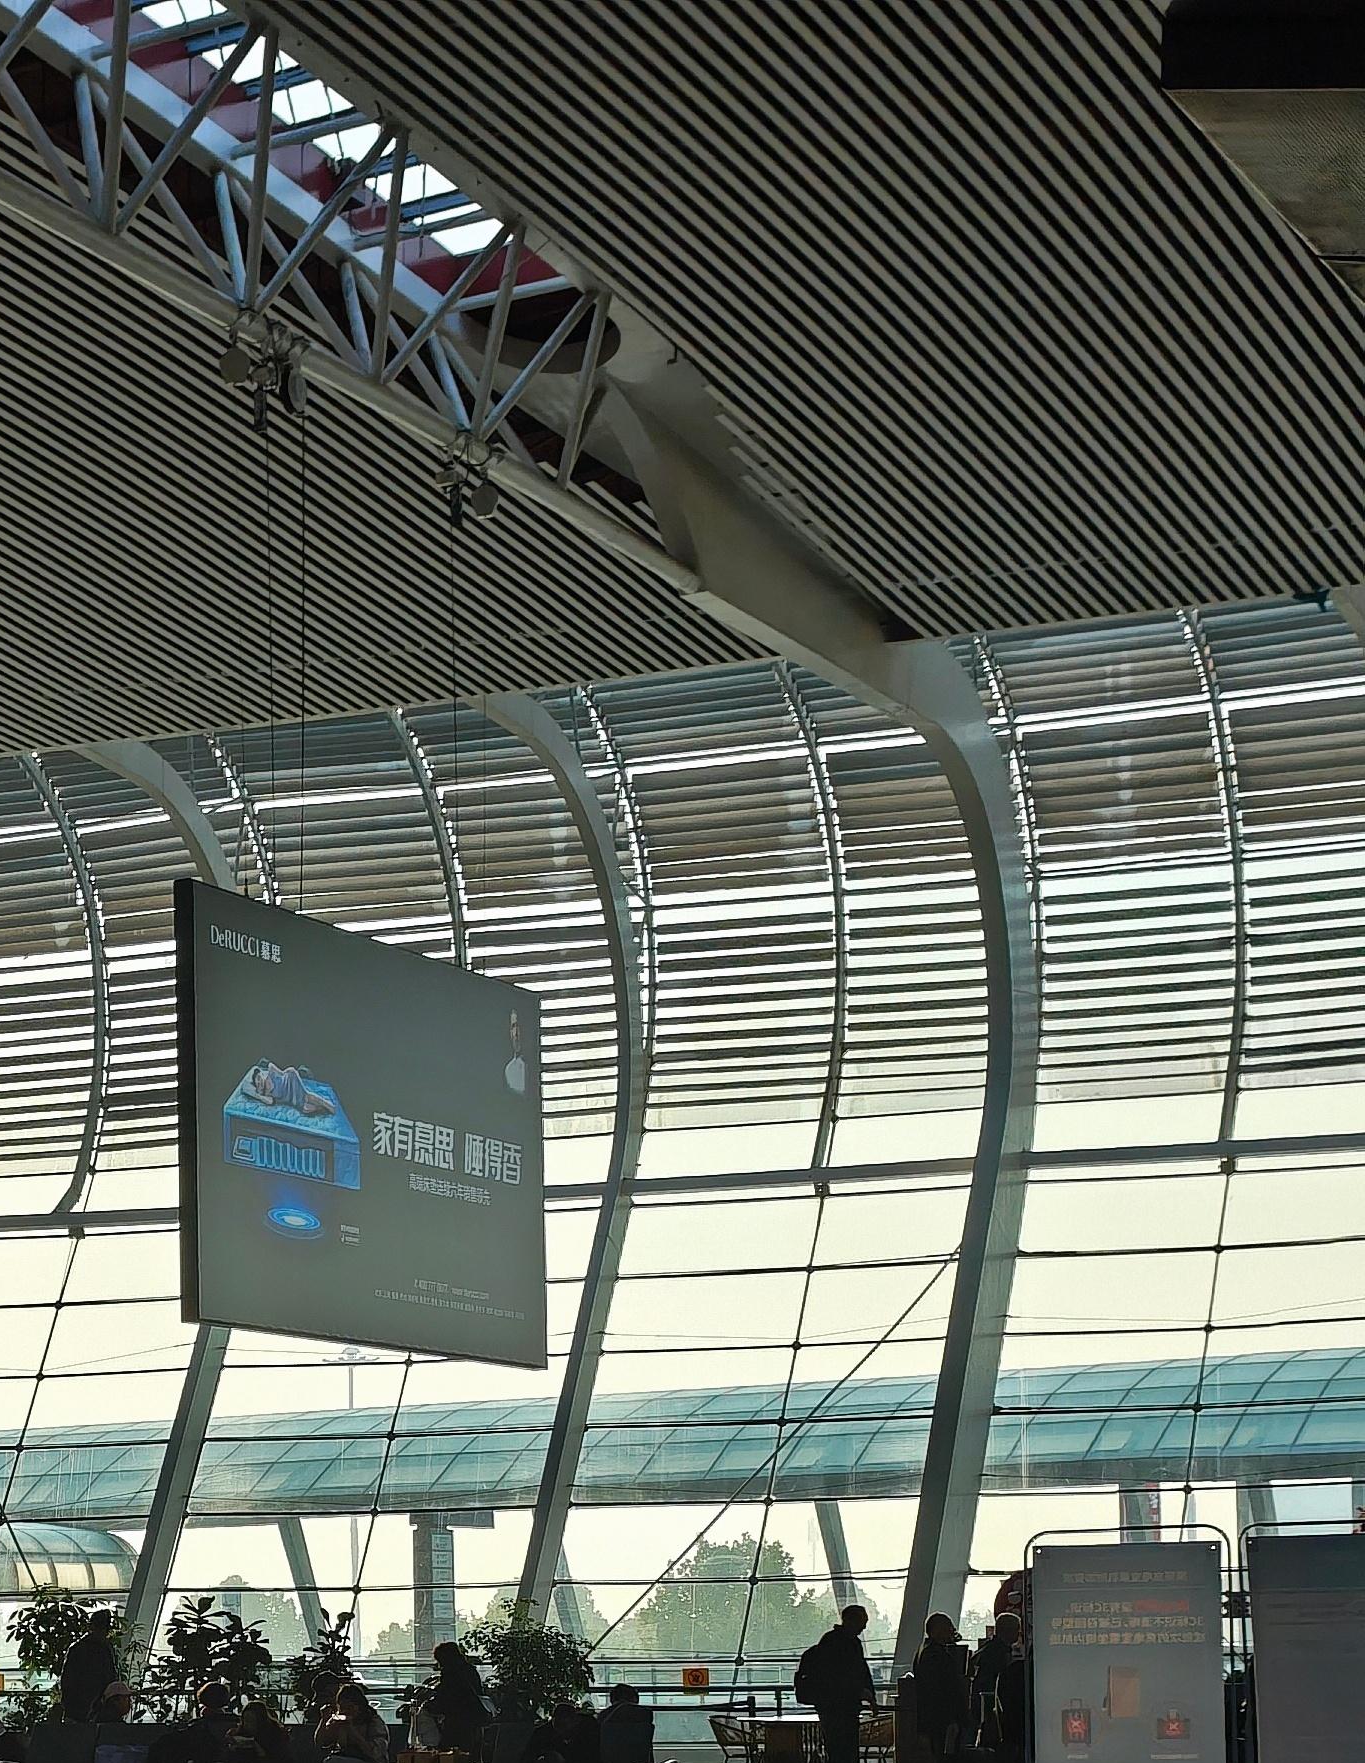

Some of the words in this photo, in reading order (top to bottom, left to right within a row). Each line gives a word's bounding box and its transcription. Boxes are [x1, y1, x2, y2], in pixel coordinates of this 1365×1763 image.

[210, 924, 260, 957] DeRUCCI
[373, 1112, 455, 1171] 家有慕思
[464, 1132, 522, 1185] 睡得香
